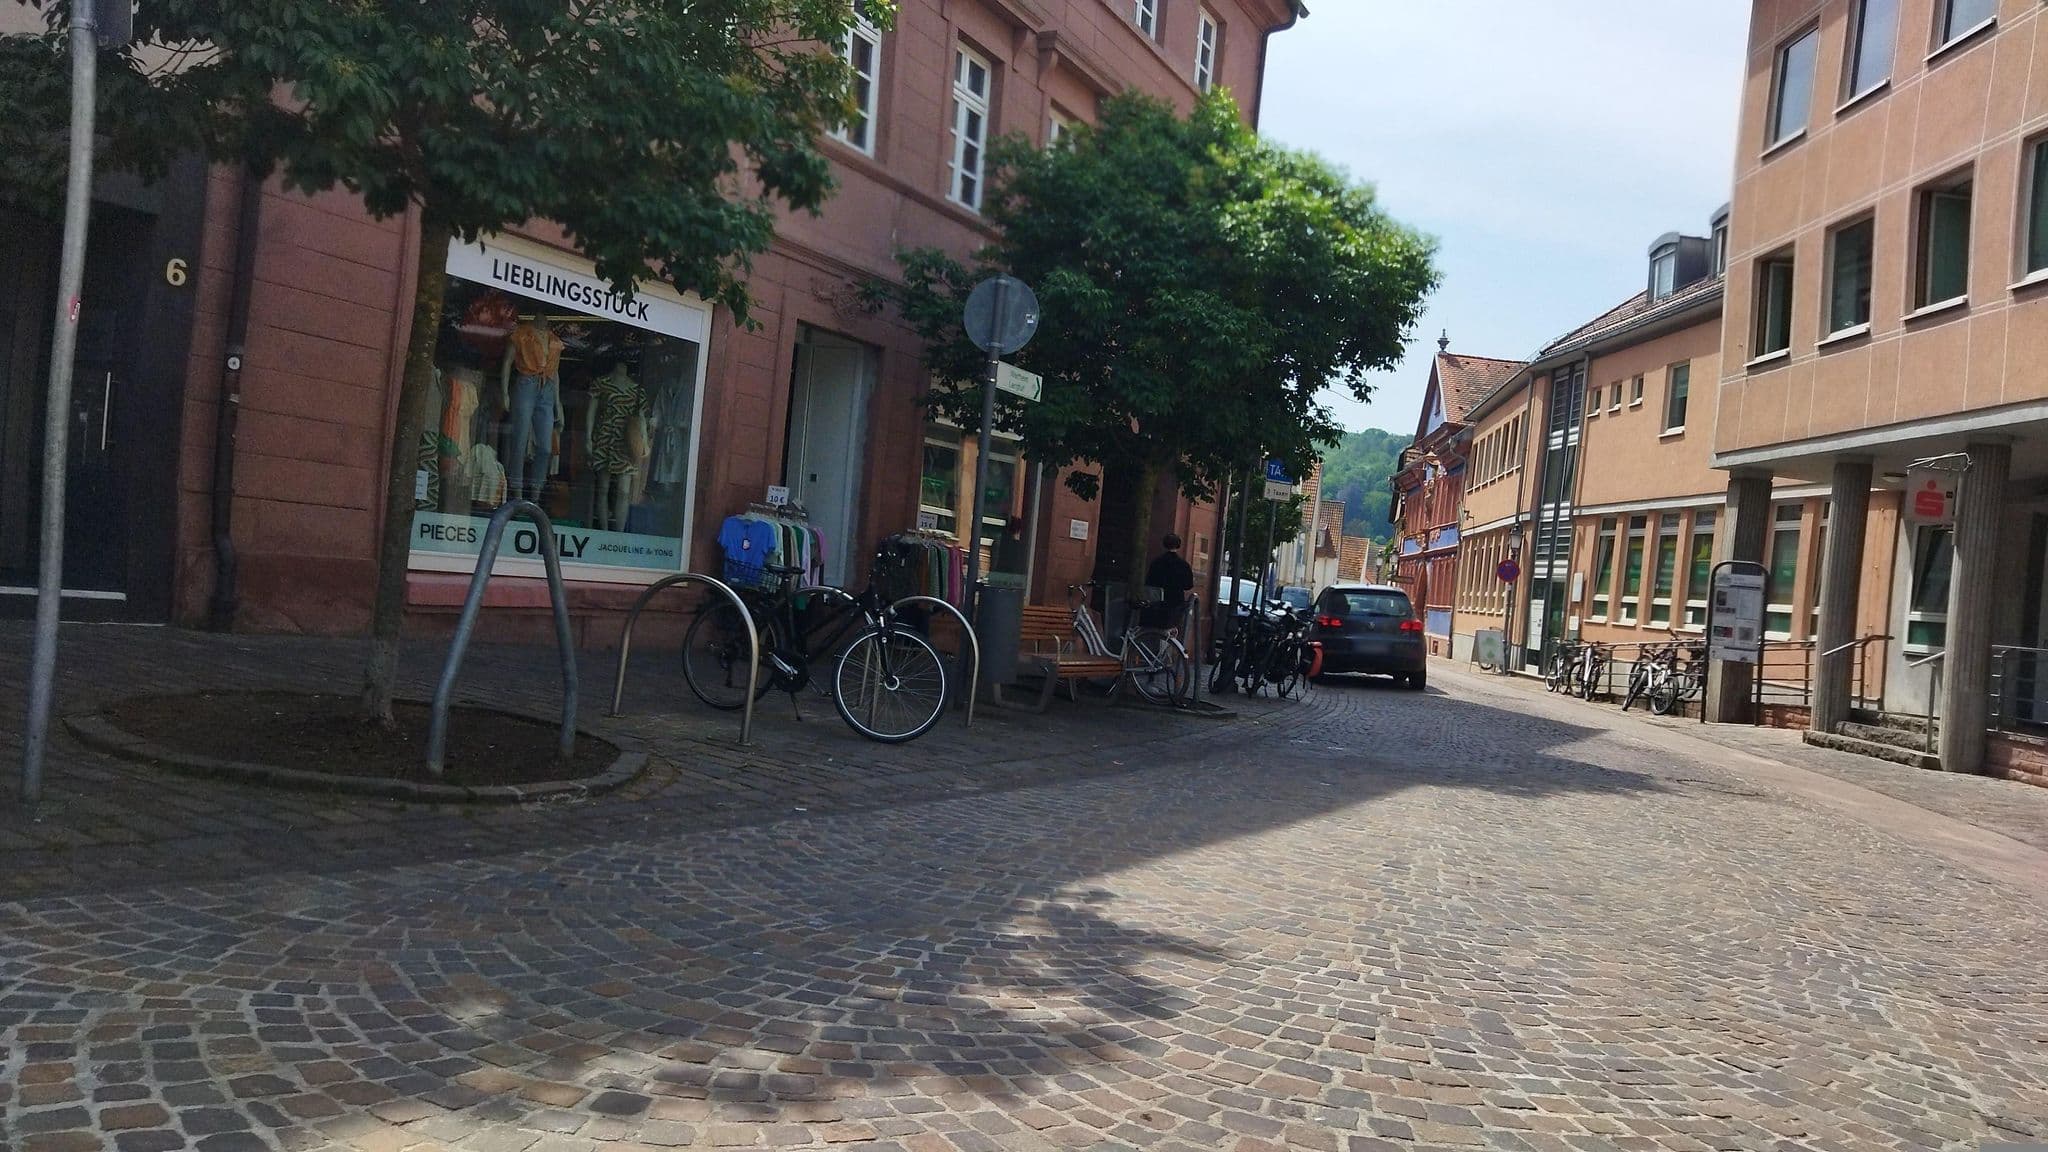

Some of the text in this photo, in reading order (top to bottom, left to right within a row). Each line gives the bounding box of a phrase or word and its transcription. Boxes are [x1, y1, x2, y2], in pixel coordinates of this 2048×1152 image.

[166, 258, 187, 286] 6
[492, 258, 650, 322] LIEBLINGSSTÜCK
[420, 523, 477, 543] PIECES
[597, 543, 644, 555] JACQUELINE
[654, 547, 674, 557] YONG
